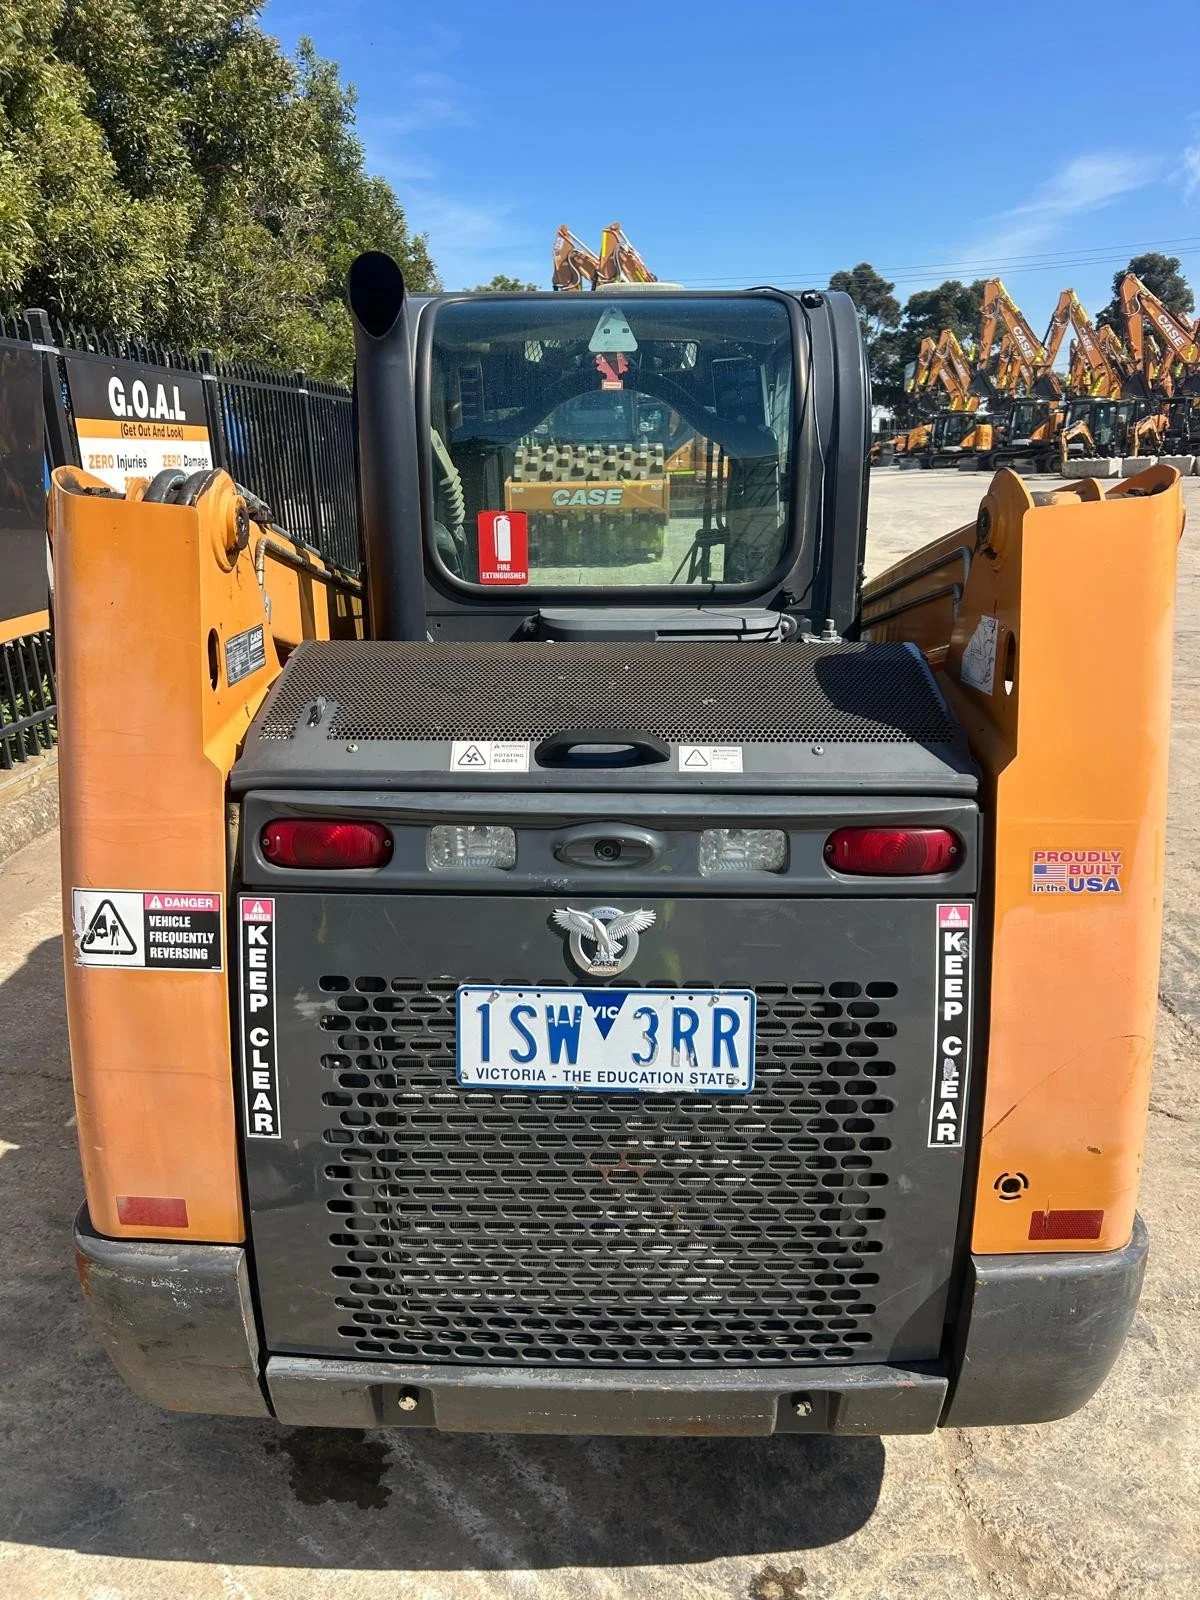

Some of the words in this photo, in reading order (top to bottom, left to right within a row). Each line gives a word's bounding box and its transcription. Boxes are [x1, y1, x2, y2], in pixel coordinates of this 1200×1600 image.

[1157, 314, 1184, 347] CASE
[1013, 325, 1034, 359] CASE
[1080, 327, 1094, 352] CASE
[108, 376, 186, 421] G.O.A.L
[120, 423, 136, 439] (Get
[138, 424, 151, 437] Out
[152, 425, 165, 438] And
[167, 425, 184, 440] Look)
[88, 454, 115, 469] ZERO
[117, 454, 148, 471] Injuries
[162, 454, 182, 467] ZERO
[183, 455, 208, 469] Damage
[551, 488, 624, 507] CASE
[497, 563, 511, 571] FIRE
[482, 572, 526, 580] EXTINGUISHER
[1033, 851, 1121, 862] PROUDLY
[1069, 864, 1122, 875] BUILT
[1033, 884, 1044, 892] in
[1046, 884, 1066, 892] the
[1068, 877, 1121, 892] USA
[164, 897, 214, 908] DANGER
[148, 915, 191, 927] VEHICLE
[244, 913, 272, 922] DANGER
[940, 920, 969, 928] DANGER
[149, 931, 215, 945] FREQUENTLY
[150, 947, 208, 960] REVERSING
[247, 924, 269, 1013] KEEP
[591, 959, 620, 967] CASE
[944, 931, 965, 1021] KEEP
[589, 1005, 619, 1021] VIC
[475, 1003, 584, 1066] 1SW
[632, 1006, 741, 1068] 3RR
[249, 1027, 275, 1133] CLEAR
[475, 1067, 547, 1081] VICTORIA
[564, 1069, 593, 1083] THE
[597, 1070, 684, 1084] EDUCATION
[689, 1071, 735, 1085] STATE
